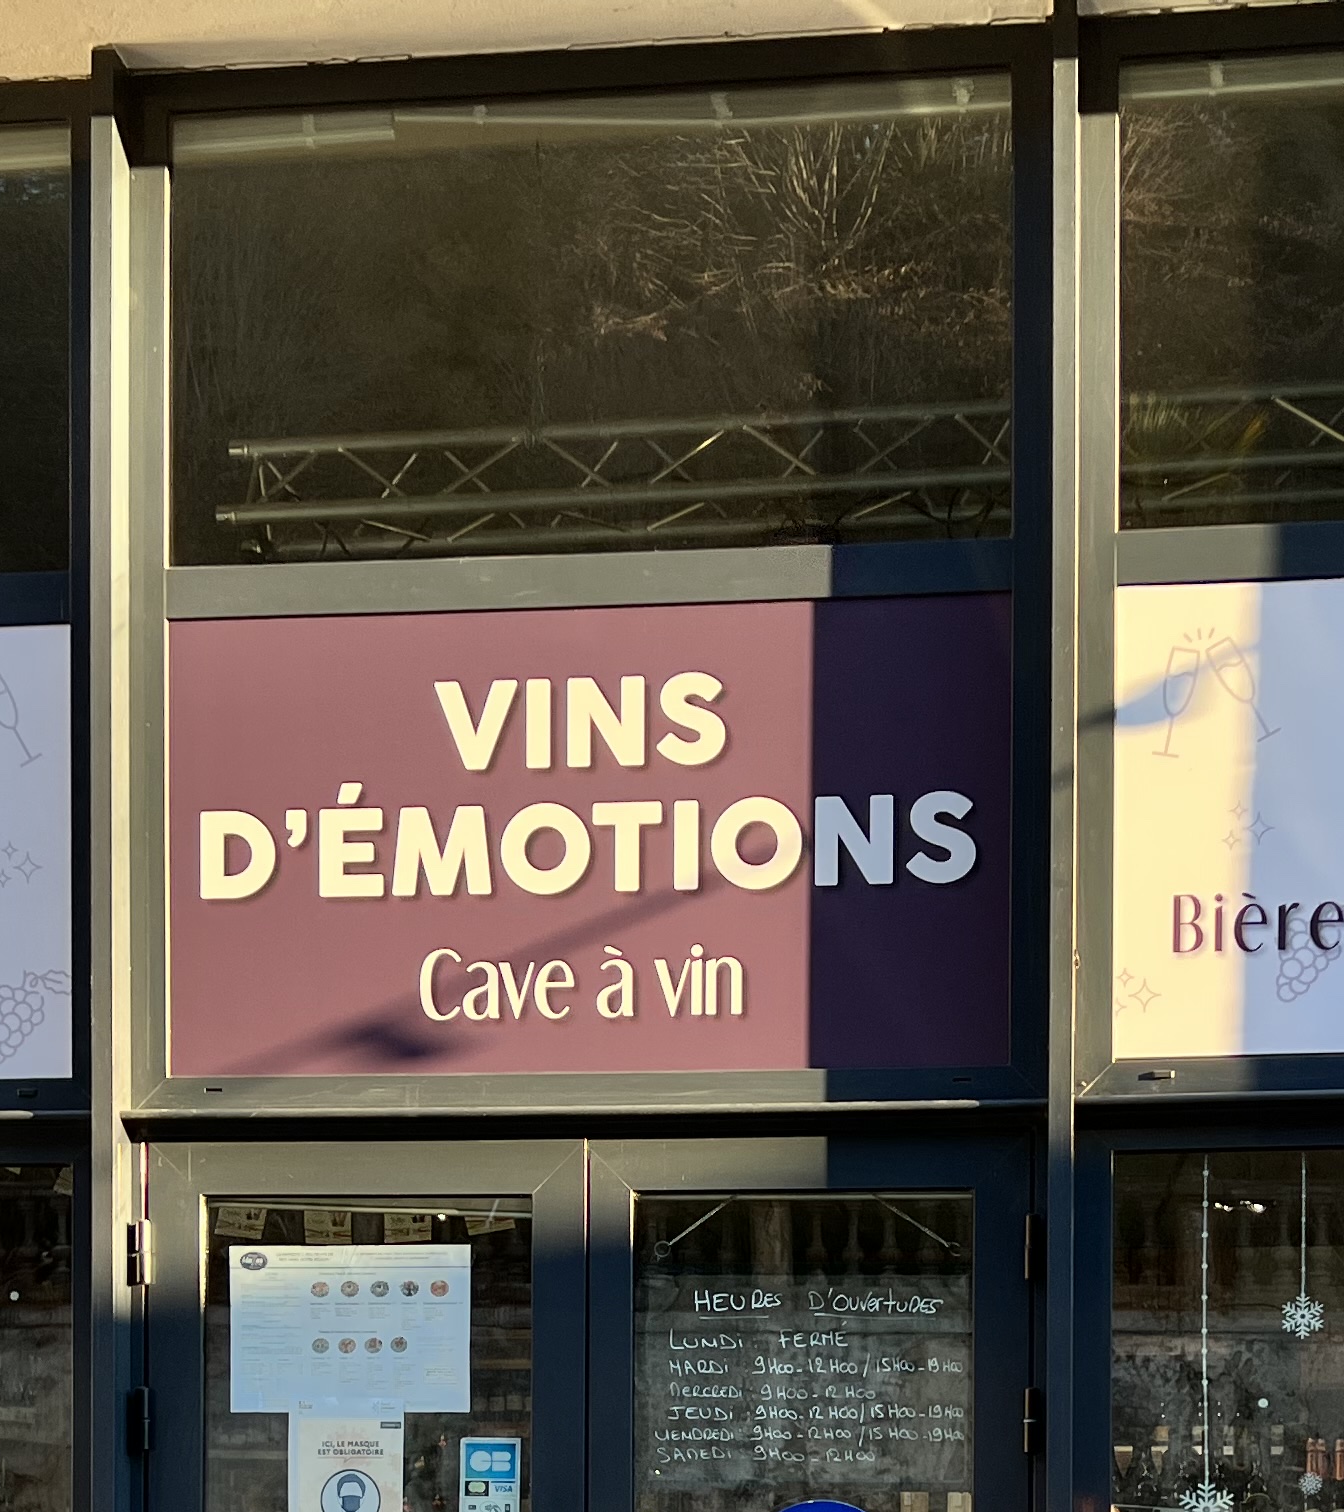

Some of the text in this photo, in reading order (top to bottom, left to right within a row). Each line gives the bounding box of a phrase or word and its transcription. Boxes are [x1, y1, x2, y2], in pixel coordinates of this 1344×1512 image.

[434, 671, 727, 771] VINS
[199, 782, 978, 900] D'ÉMOTIONS
[419, 942, 746, 1022] Cave à vin
[333, 1448, 384, 1456] OBLIGATOIRE
[494, 1485, 513, 1493] VISA
